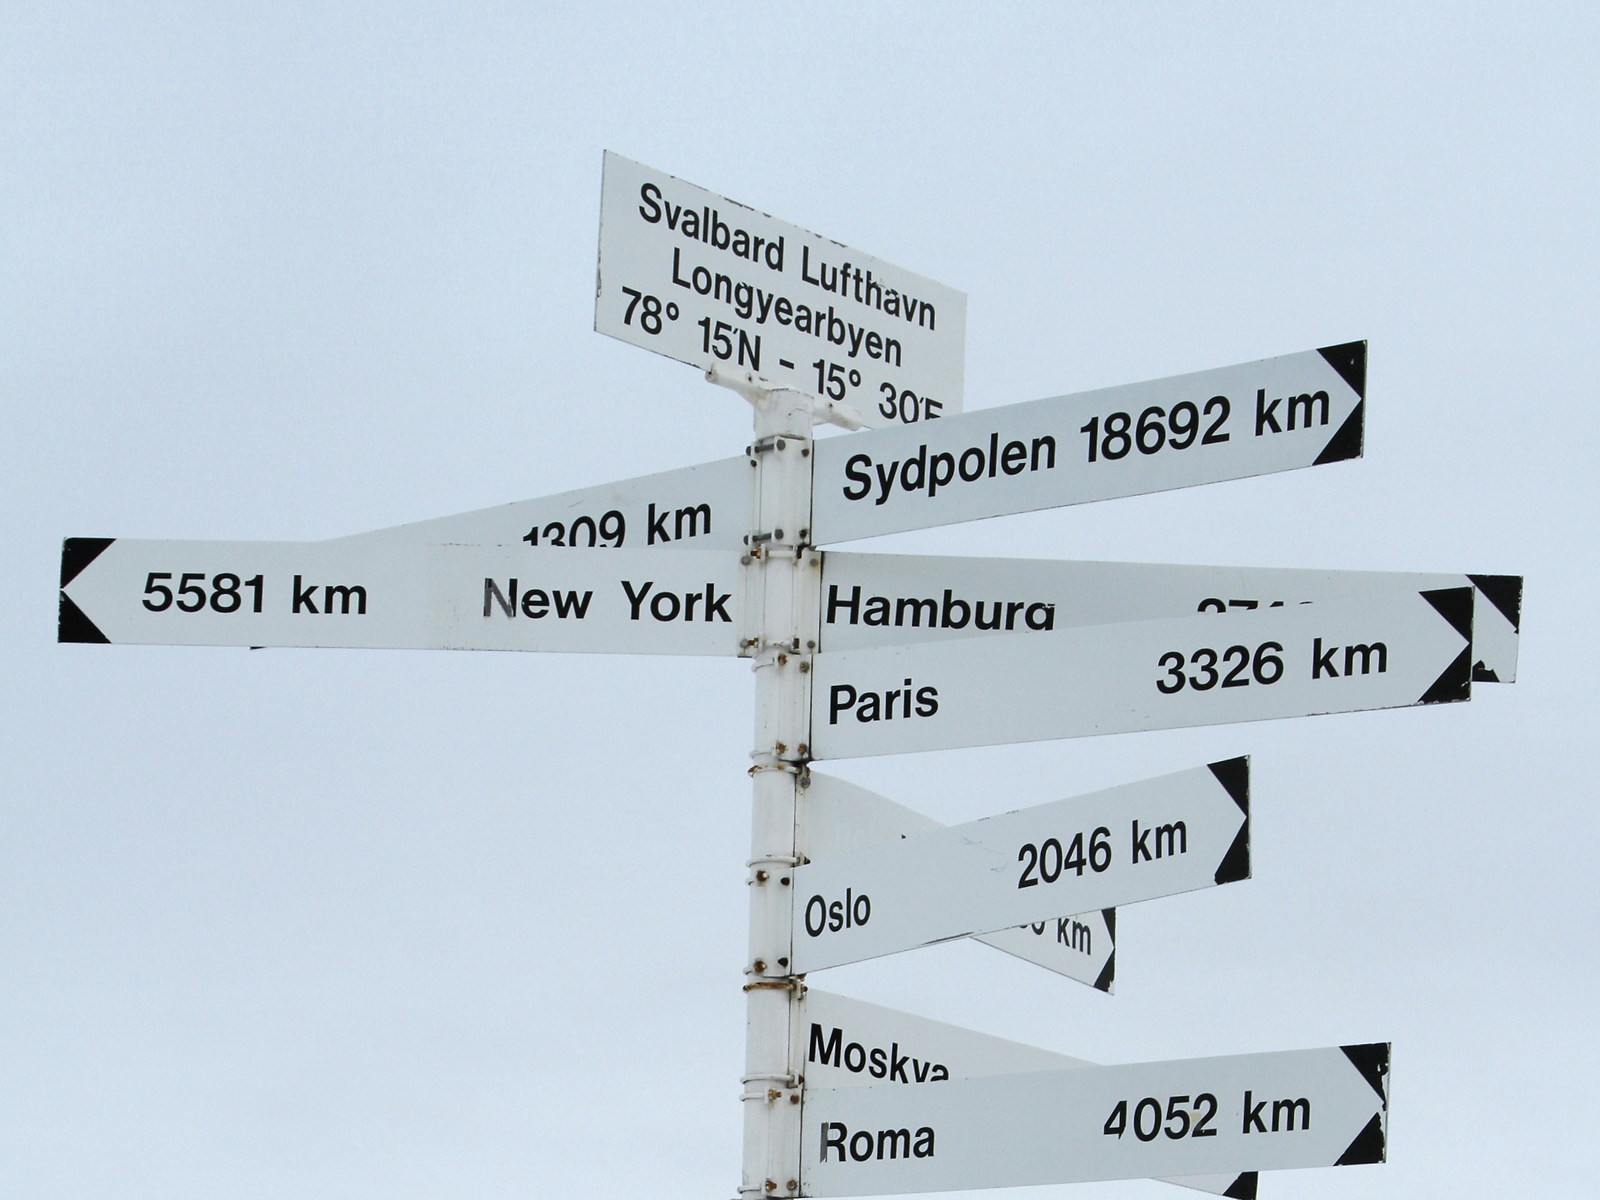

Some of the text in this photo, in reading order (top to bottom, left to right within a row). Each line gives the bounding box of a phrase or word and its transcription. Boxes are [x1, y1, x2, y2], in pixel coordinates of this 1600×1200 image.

[639, 183, 935, 331] Svalbard Lufthavn
[621, 286, 679, 335] 78°
[812, 358, 861, 401] 15°
[672, 246, 901, 367] Longyearbyen
[843, 388, 1331, 506] Sydpolen 18692 km
[647, 502, 711, 546] km
[142, 571, 733, 623] 5581 km New York
[828, 637, 1388, 725] Paris 3326 km
[804, 819, 1187, 938] Oslo 2046 km
[1057, 918, 1091, 955] km
[808, 1023, 950, 1085] Moskva
[820, 1090, 1311, 1163] Roma 4052 km
